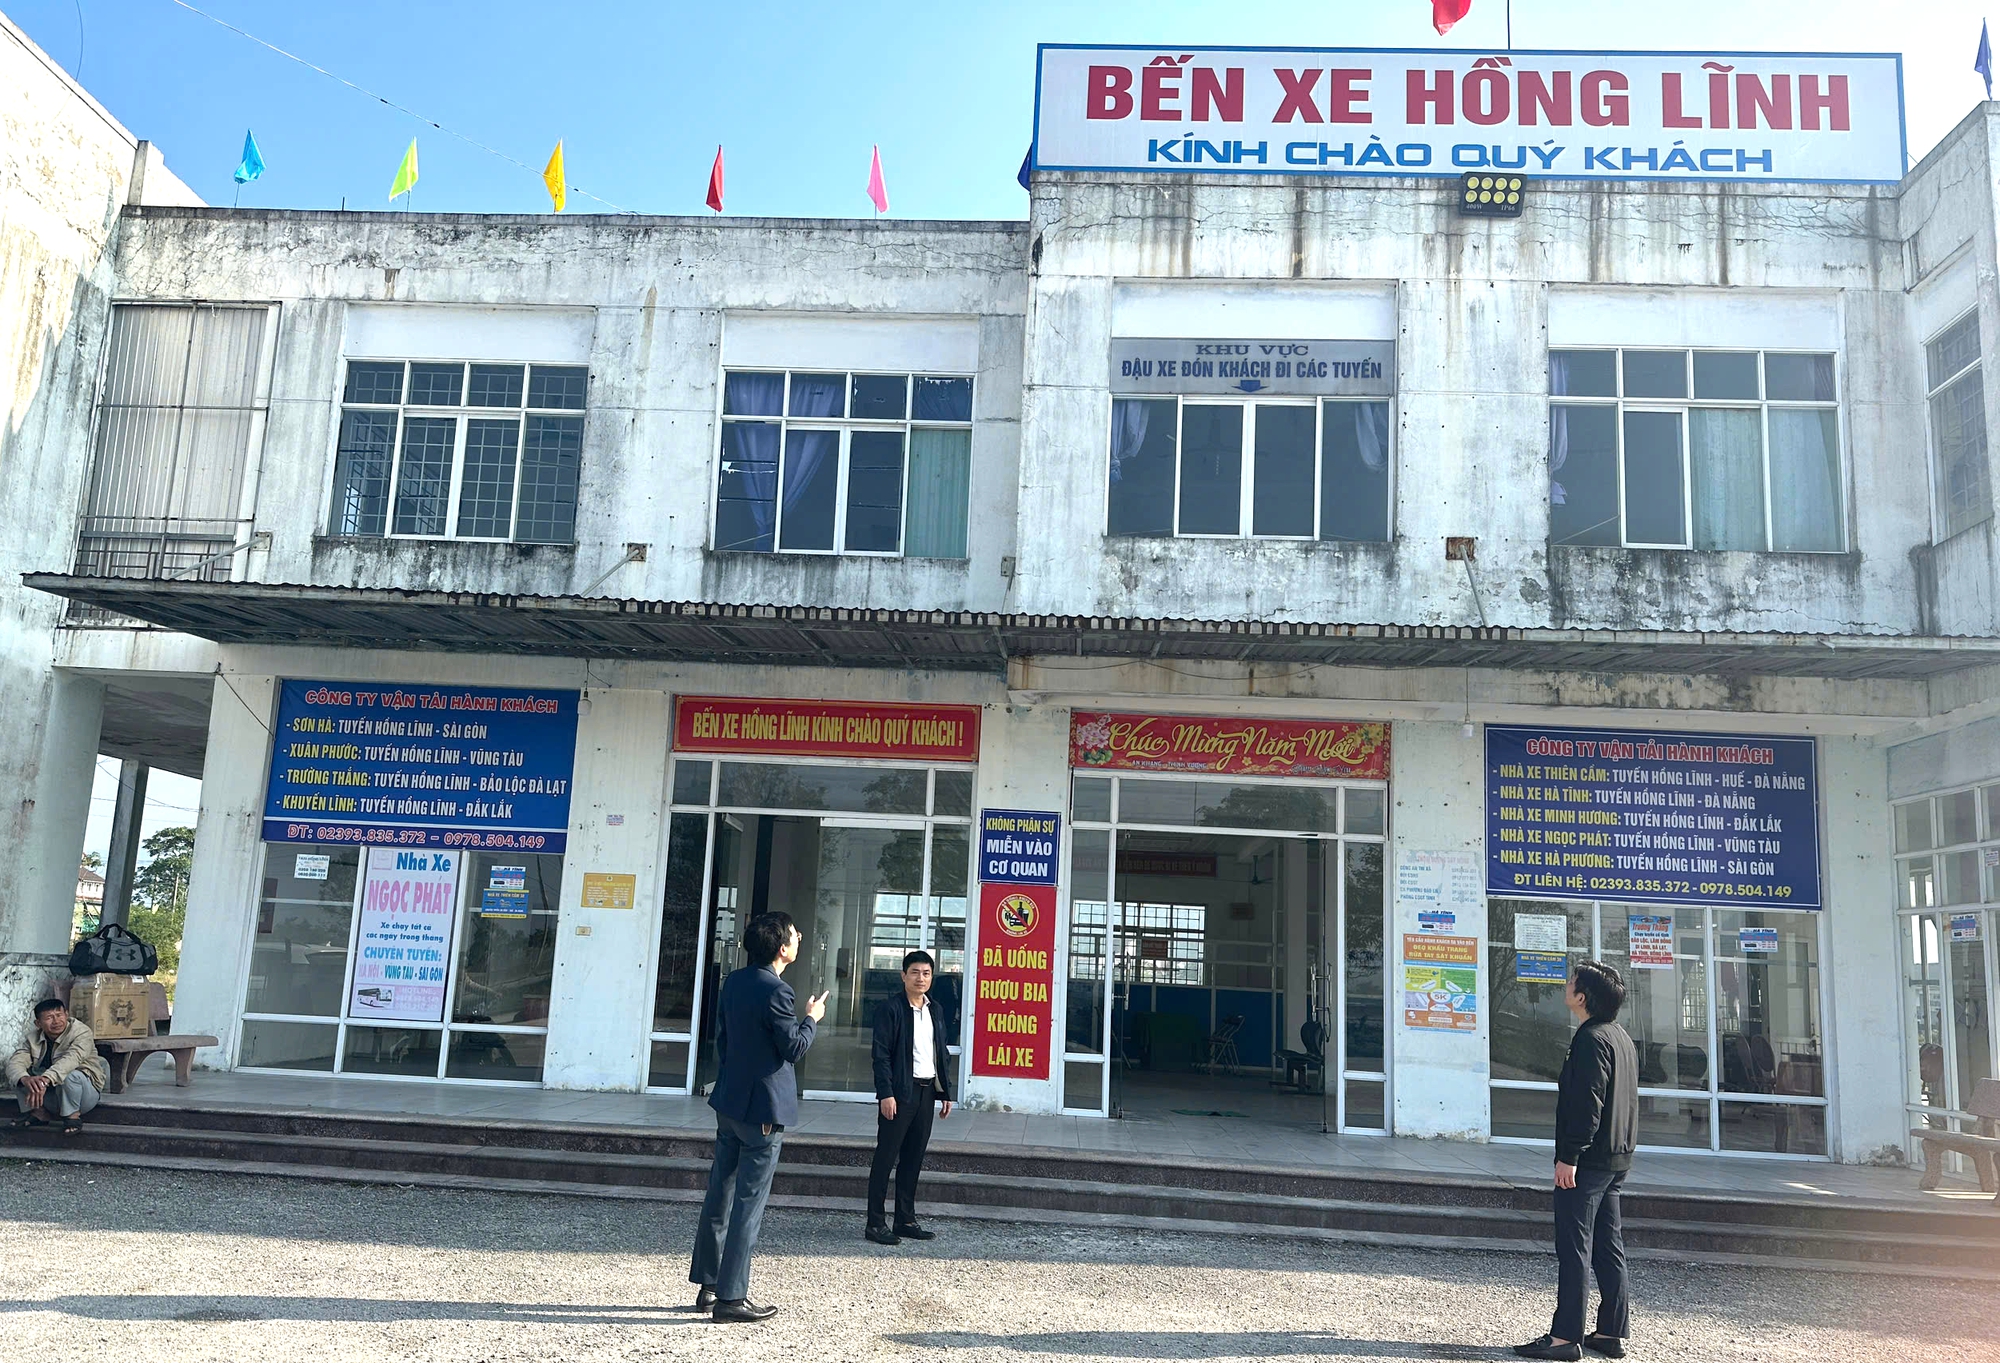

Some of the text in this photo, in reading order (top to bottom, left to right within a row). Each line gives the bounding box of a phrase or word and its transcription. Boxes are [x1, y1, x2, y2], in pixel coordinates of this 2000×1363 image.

[1085, 54, 1850, 131] BẾN XE HỒNG LĨNH
[1147, 132, 1772, 172] KÍNH CHÀO QUÝ KHÁCH
[1195, 343, 1309, 358] KHU VỰC
[1121, 356, 1381, 381] ĐẬU XE ĐÓN KHÁCH ĐI CÁC TUYẾN
[304, 686, 558, 714] CÔNG TY VẬN TẢI HÀNH KHÁCH
[292, 716, 487, 739] SƠN HÀ: TUYẾN HỒNG LĨNH SÀI GÒN
[692, 707, 720, 738] BẾN
[720, 713, 739, 739] XE
[740, 708, 778, 740] HỒNG
[779, 710, 810, 741] LĨNH
[811, 711, 844, 742] KÍNH
[845, 712, 881, 744] CHÀO
[883, 713, 910, 748] QUÝ
[289, 741, 523, 767] XUÂN PHƯỚC: TUYẾN HỒNG LĨNH VŨNG TÀU
[1108, 717, 1366, 772] Chúc Mừng Năm Mới
[1526, 735, 1774, 765] CÔNG TY VẬN TẢI HÀNH KHÁCH
[287, 766, 566, 797] TRƯỜNG THẮNG: TUYẾN HỒNG LĨNH BẢO LỘC ĐÀ LẠT
[1500, 762, 1805, 790] NHÀ XE THIÊN CẦM: TUYẾN HỒNG LĨNH HUẾ ĐÀ NẴNG
[282, 791, 513, 818] KHUYẾN LĨNH: TUYẾN HỒNG LĨNH ĐẮK LẮK
[1500, 785, 1755, 810] NHÀ XE HÀ TĨNH: TUYẾN HỒNG LĨNH ĐÀ NẴNG
[986, 815, 1056, 836] KHÔNG PHẬN SỰ
[1500, 806, 1782, 832] NHÀ XE MINH HƯƠNG: TUYẾN HỒNG LĨNH ĐẮK LẮK
[287, 823, 545, 849] ĐT: 02393.835.372 0978.504.149
[986, 834, 1053, 856] MIỄN VÀO
[1500, 828, 1780, 854] NHÀ XE NGỌC PHÁT: TUYẾN HỒNG LĨNH VŨNG TÀU
[396, 852, 452, 873] Nhà Xe
[989, 859, 1048, 877] CƠ QUAN
[1500, 849, 1774, 876] NHÀ XE HÀ PHƯƠNG: TUYẾN HỒNG LĨNH SÀI GÒN
[366, 879, 411, 921] NGỌC
[412, 875, 452, 914] PHÁT
[1513, 872, 1792, 898] ĐT LIÊN HỆ: 02393.835.372 0978.504.149
[983, 943, 1048, 970] ĐÃ UỐNG
[980, 978, 1048, 1004] RƯỢU BIA
[987, 1010, 1038, 1035] KHÔNG
[987, 1042, 1034, 1067] LÁI XE
